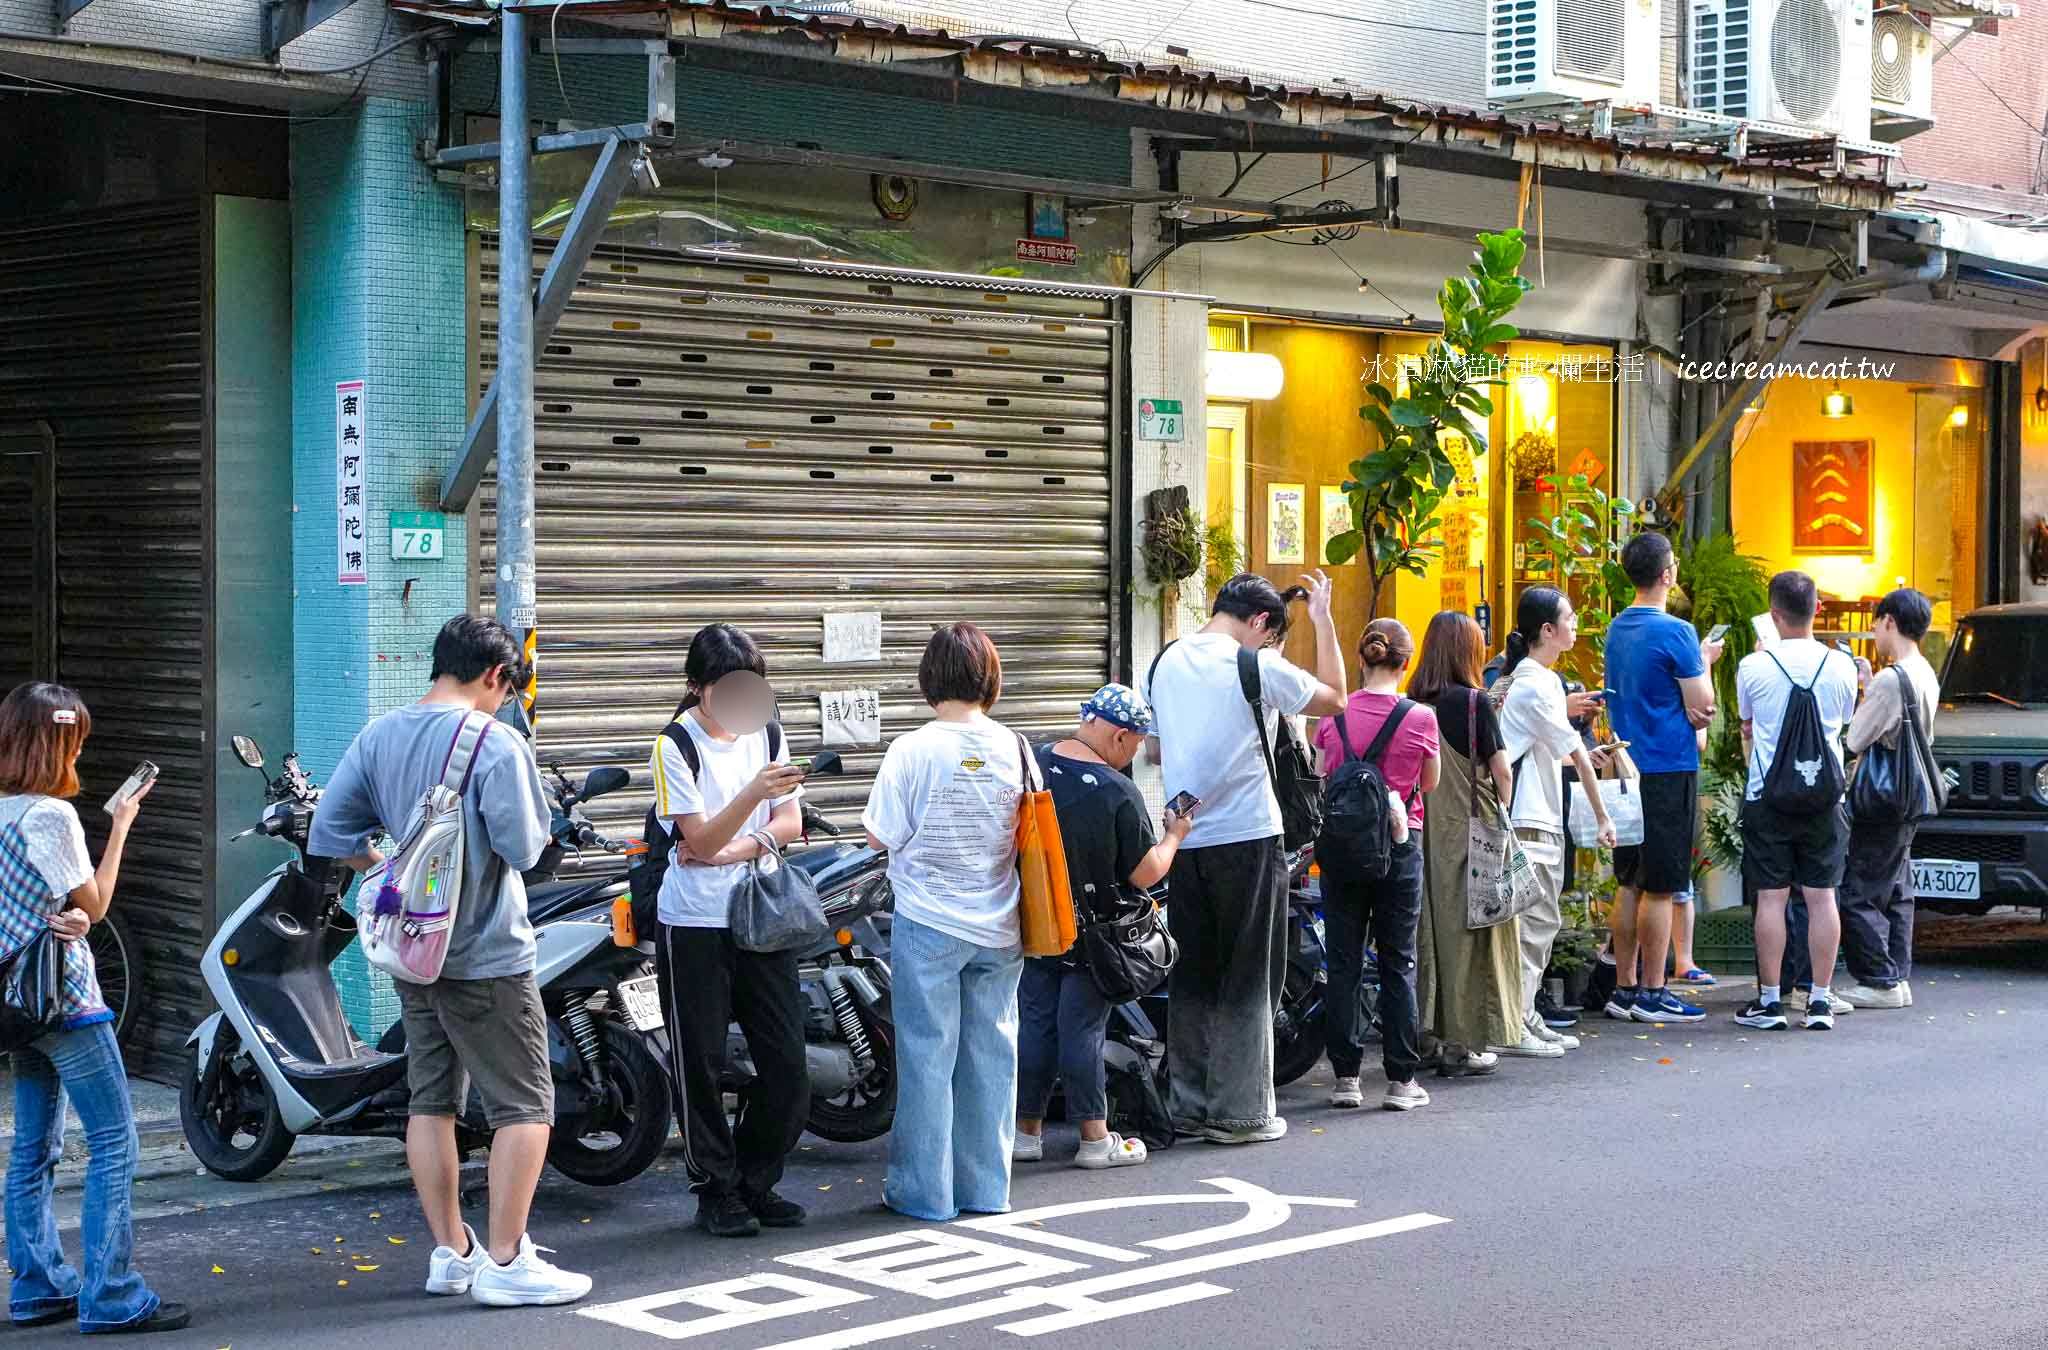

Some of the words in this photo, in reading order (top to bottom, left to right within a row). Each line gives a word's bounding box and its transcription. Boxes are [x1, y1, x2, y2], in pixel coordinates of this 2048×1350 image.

[1159, 417, 1176, 435] 78
[343, 395, 363, 571] 南無阿彌陀佛
[403, 532, 433, 555] 78
